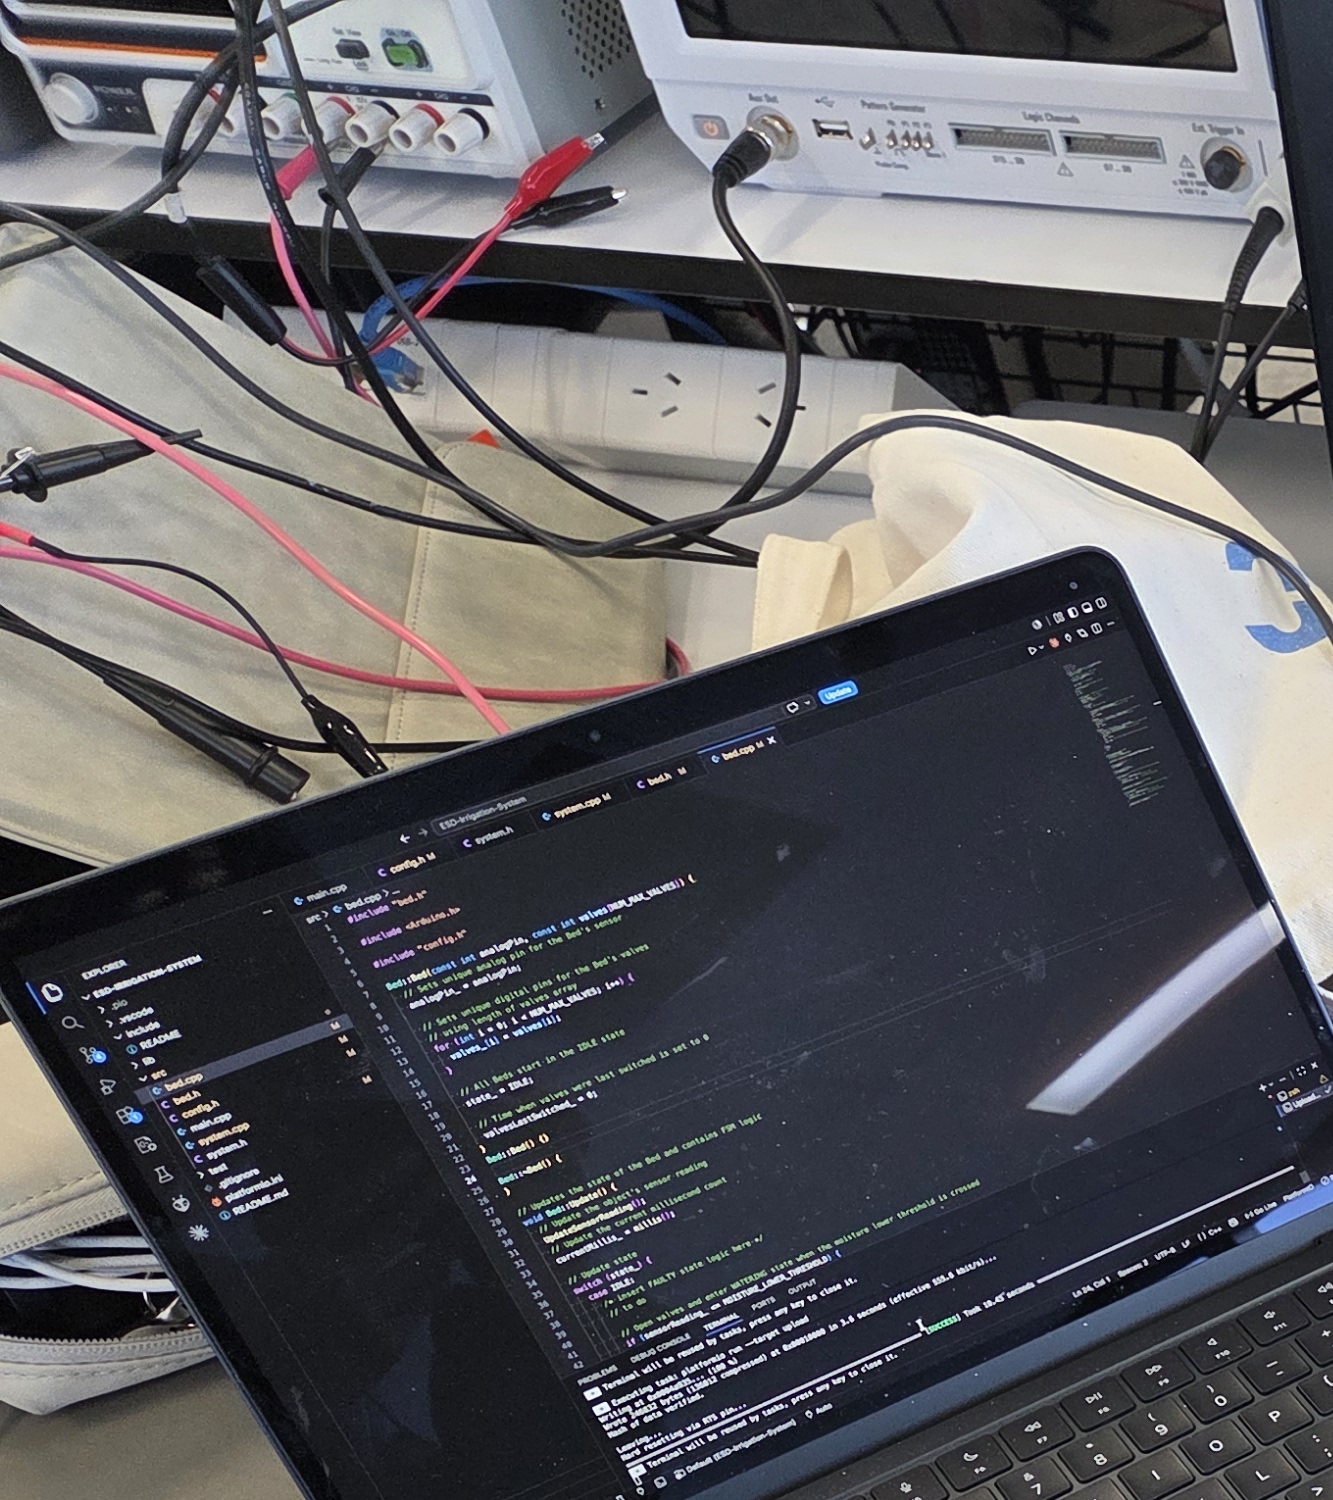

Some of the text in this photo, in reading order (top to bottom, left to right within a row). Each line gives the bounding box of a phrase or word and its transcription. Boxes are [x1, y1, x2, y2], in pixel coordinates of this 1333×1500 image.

[825, 686, 851, 701] Update
[722, 745, 755, 760] bed.cpp
[647, 773, 672, 785] bed.h
[554, 797, 601, 818] system.cpp
[475, 826, 514, 844] system.h
[390, 856, 426, 874] config.h
[307, 884, 347, 902] main.cpp
[348, 905, 389, 923] #include
[361, 927, 402, 946] #include
[373, 950, 415, 968] #include
[417, 915, 621, 992] Sets unique analog pin for the Bed's sensor
[82, 960, 127, 980] EXPLORER
[126, 1022, 160, 1038] include
[139, 1029, 181, 1049] README
[164, 1074, 203, 1091] bed.cpp
[172, 1090, 201, 1105] bed.h
[182, 1100, 220, 1118] config.h
[190, 1113, 232, 1132] main.cpp
[198, 1123, 250, 1146] system.cpp
[206, 1139, 248, 1160] system.h
[219, 1168, 260, 1189] .gitignore
[225, 1174, 283, 1203] platformio.ini
[551, 1161, 708, 1227] Update the object's sensor reading
[232, 1188, 289, 1215] README.md
[788, 1278, 816, 1294] OUTPUT
[703, 1313, 739, 1331] TERMINAL
[602, 1283, 842, 1390] Terminal will reused tasks, press close
[656, 1333, 691, 1352] CONSOLE
